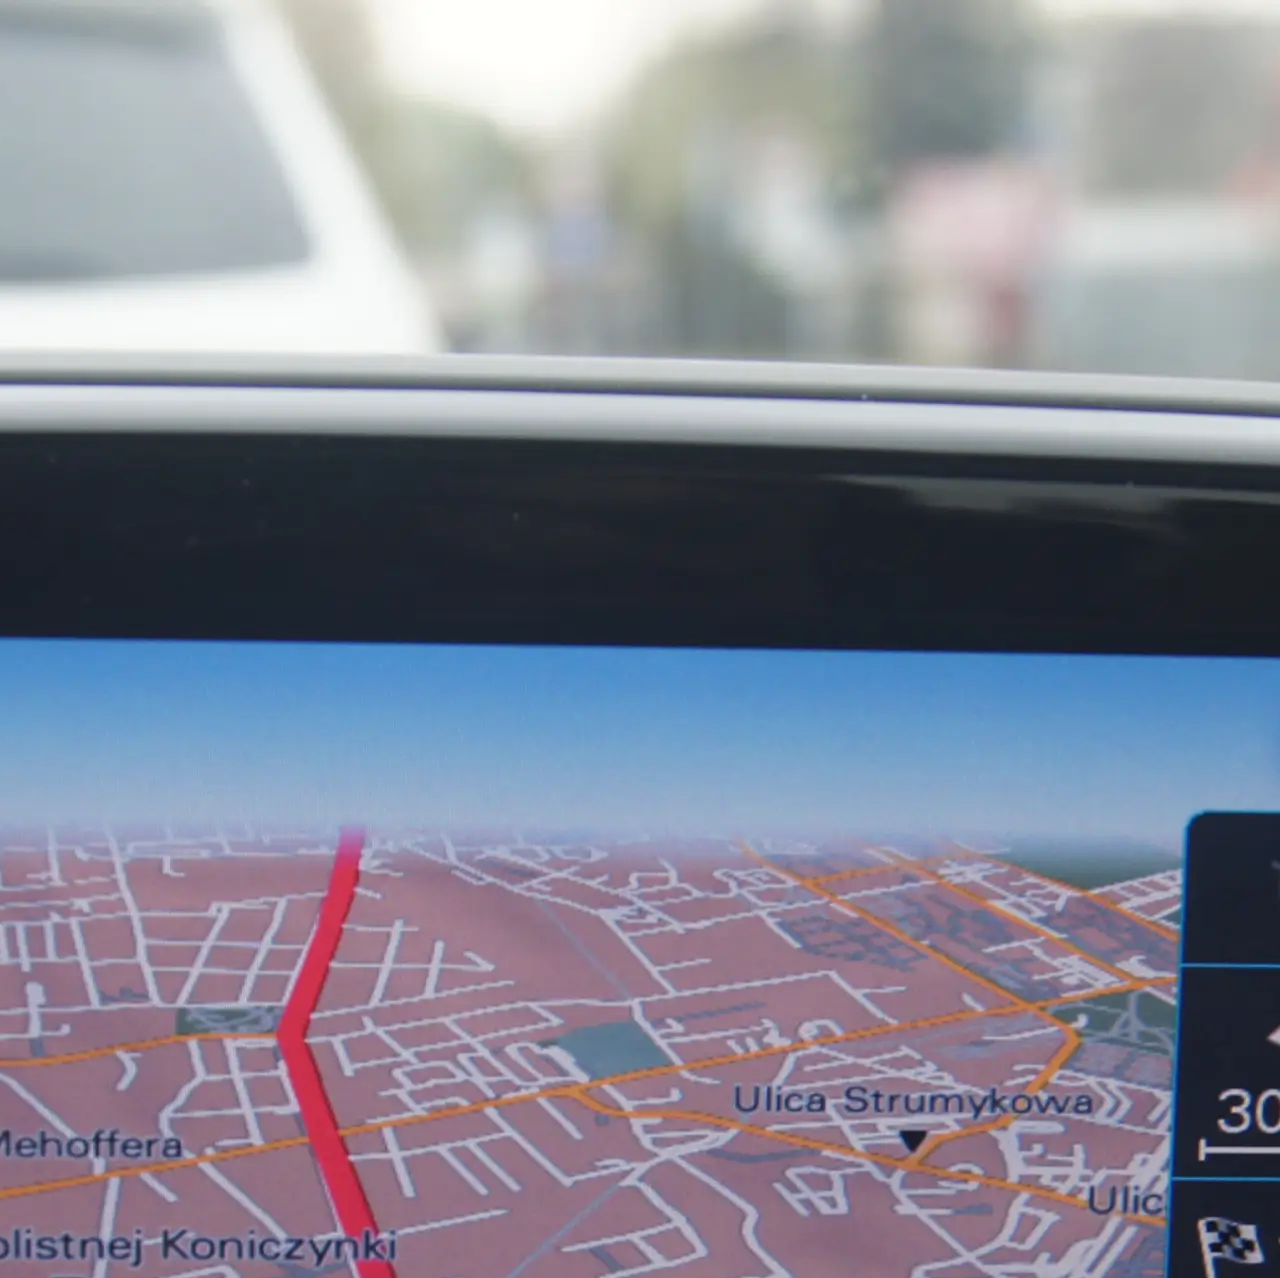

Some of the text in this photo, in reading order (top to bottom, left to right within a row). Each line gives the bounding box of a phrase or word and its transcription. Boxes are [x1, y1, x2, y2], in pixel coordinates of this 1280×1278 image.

[734, 1084, 1094, 1120] Ulica Strumykowa
[1088, 1185, 1167, 1215] Ulic
[162, 1229, 397, 1266] Koniczynki
